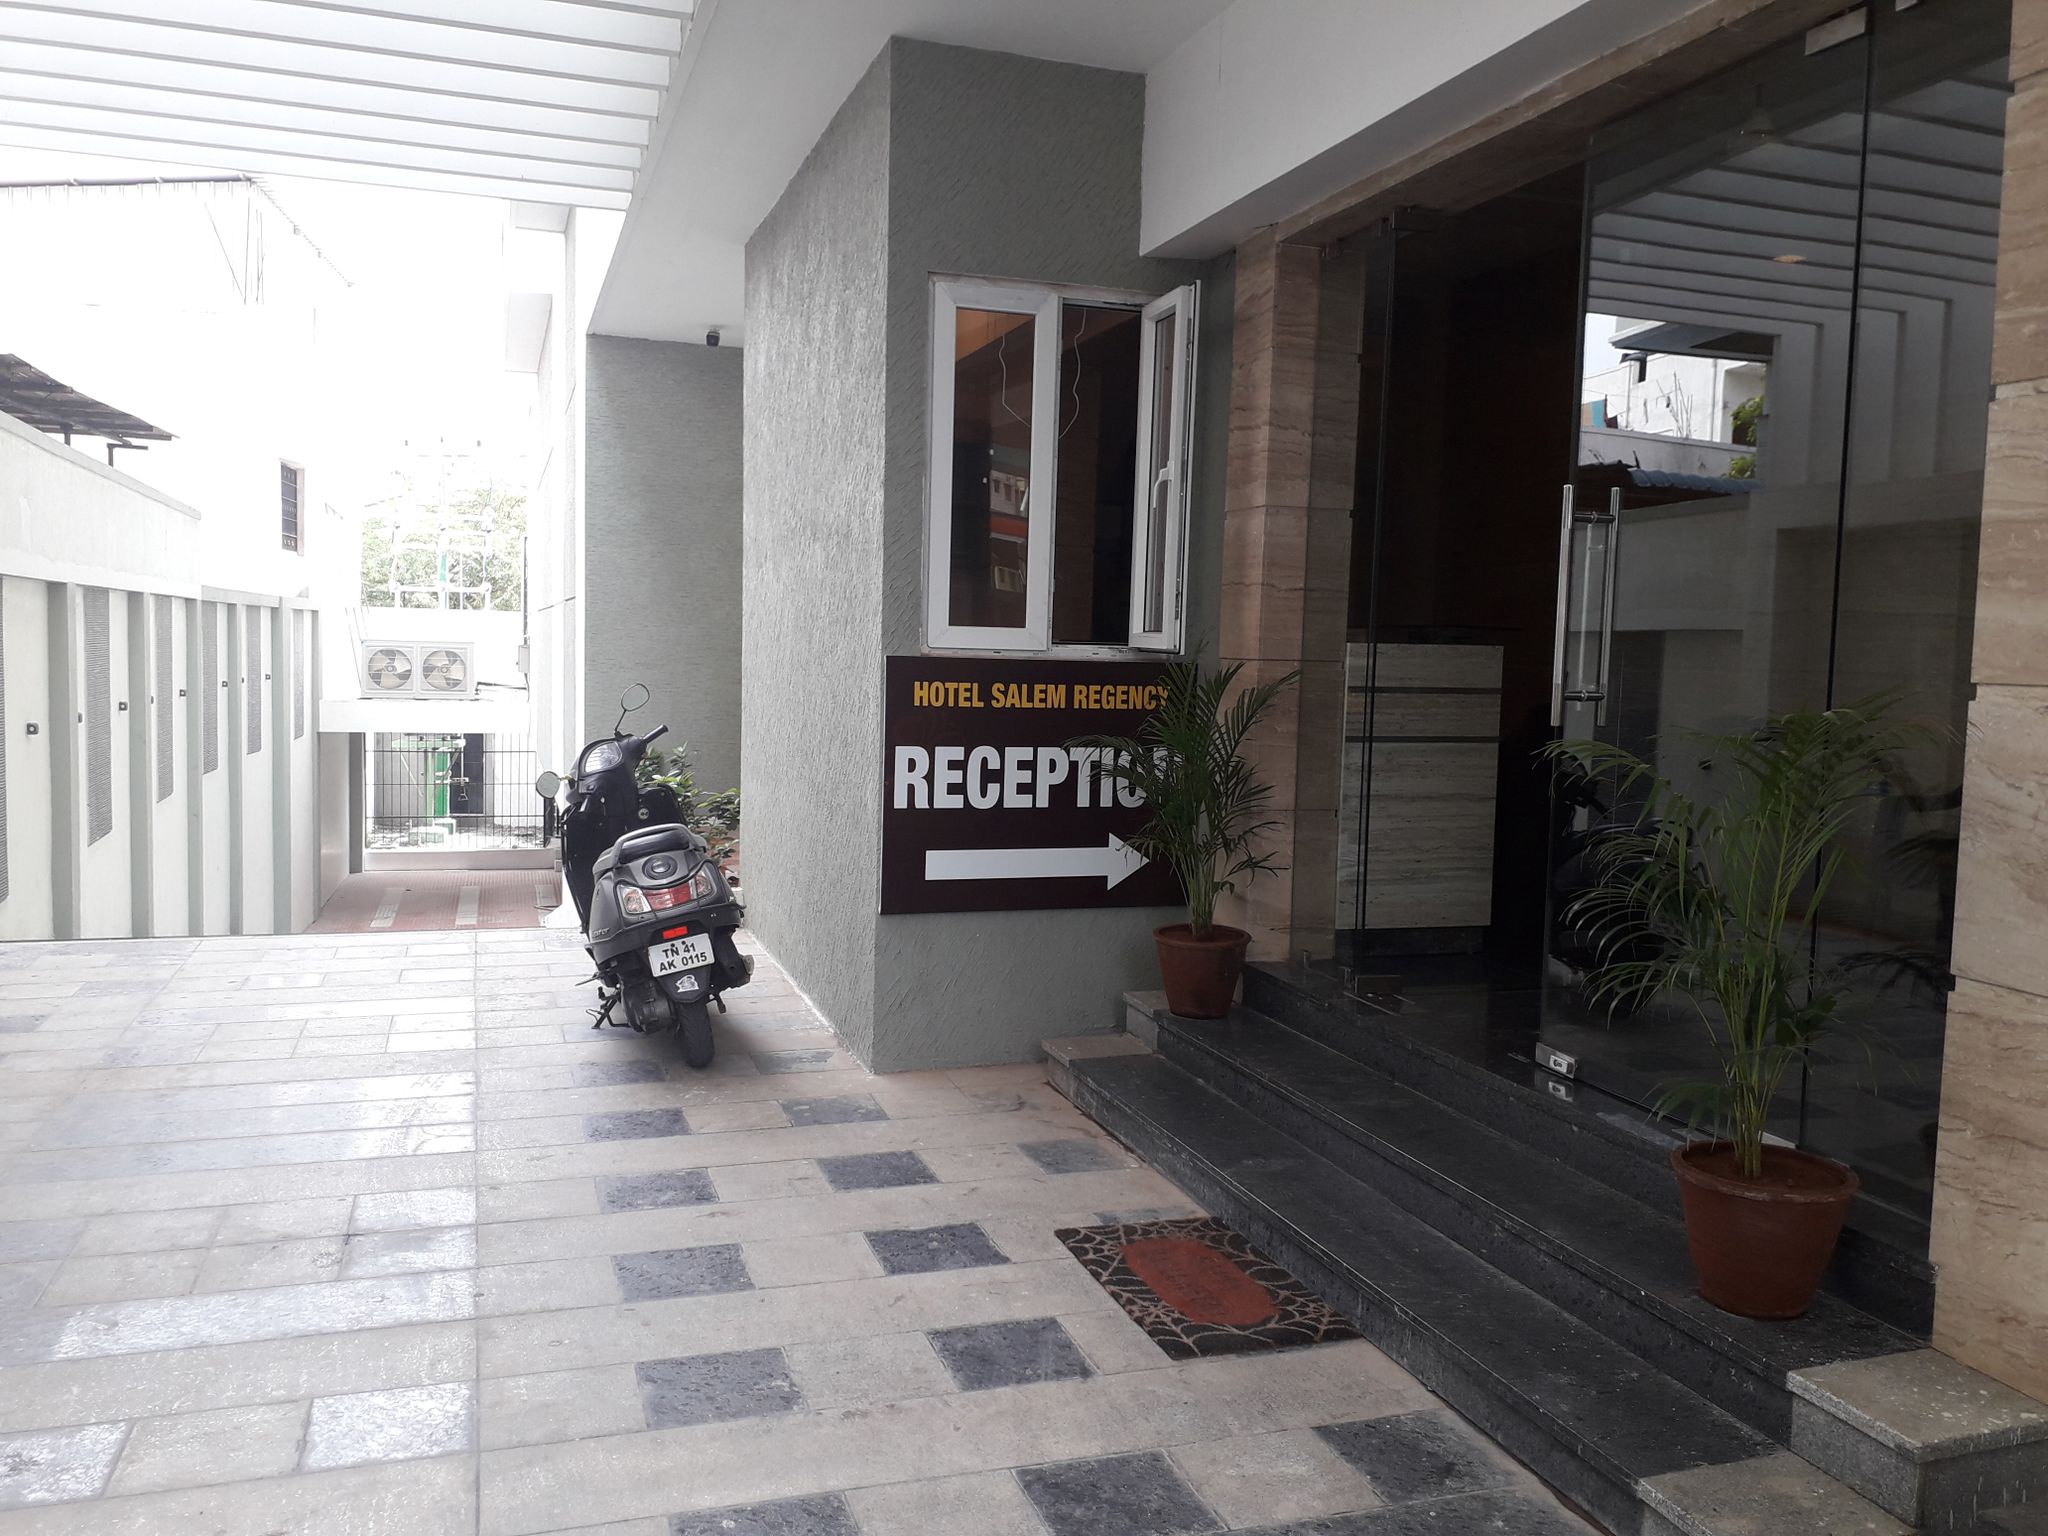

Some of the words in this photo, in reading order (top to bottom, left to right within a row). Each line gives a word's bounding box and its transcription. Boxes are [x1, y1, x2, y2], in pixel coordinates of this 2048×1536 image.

[914, 681, 984, 708] HOTEL
[991, 683, 1066, 709] SALEM
[662, 946, 680, 959] TN
[683, 943, 696, 954] 41
[660, 959, 677, 972] AK
[681, 952, 707, 966] 0115
